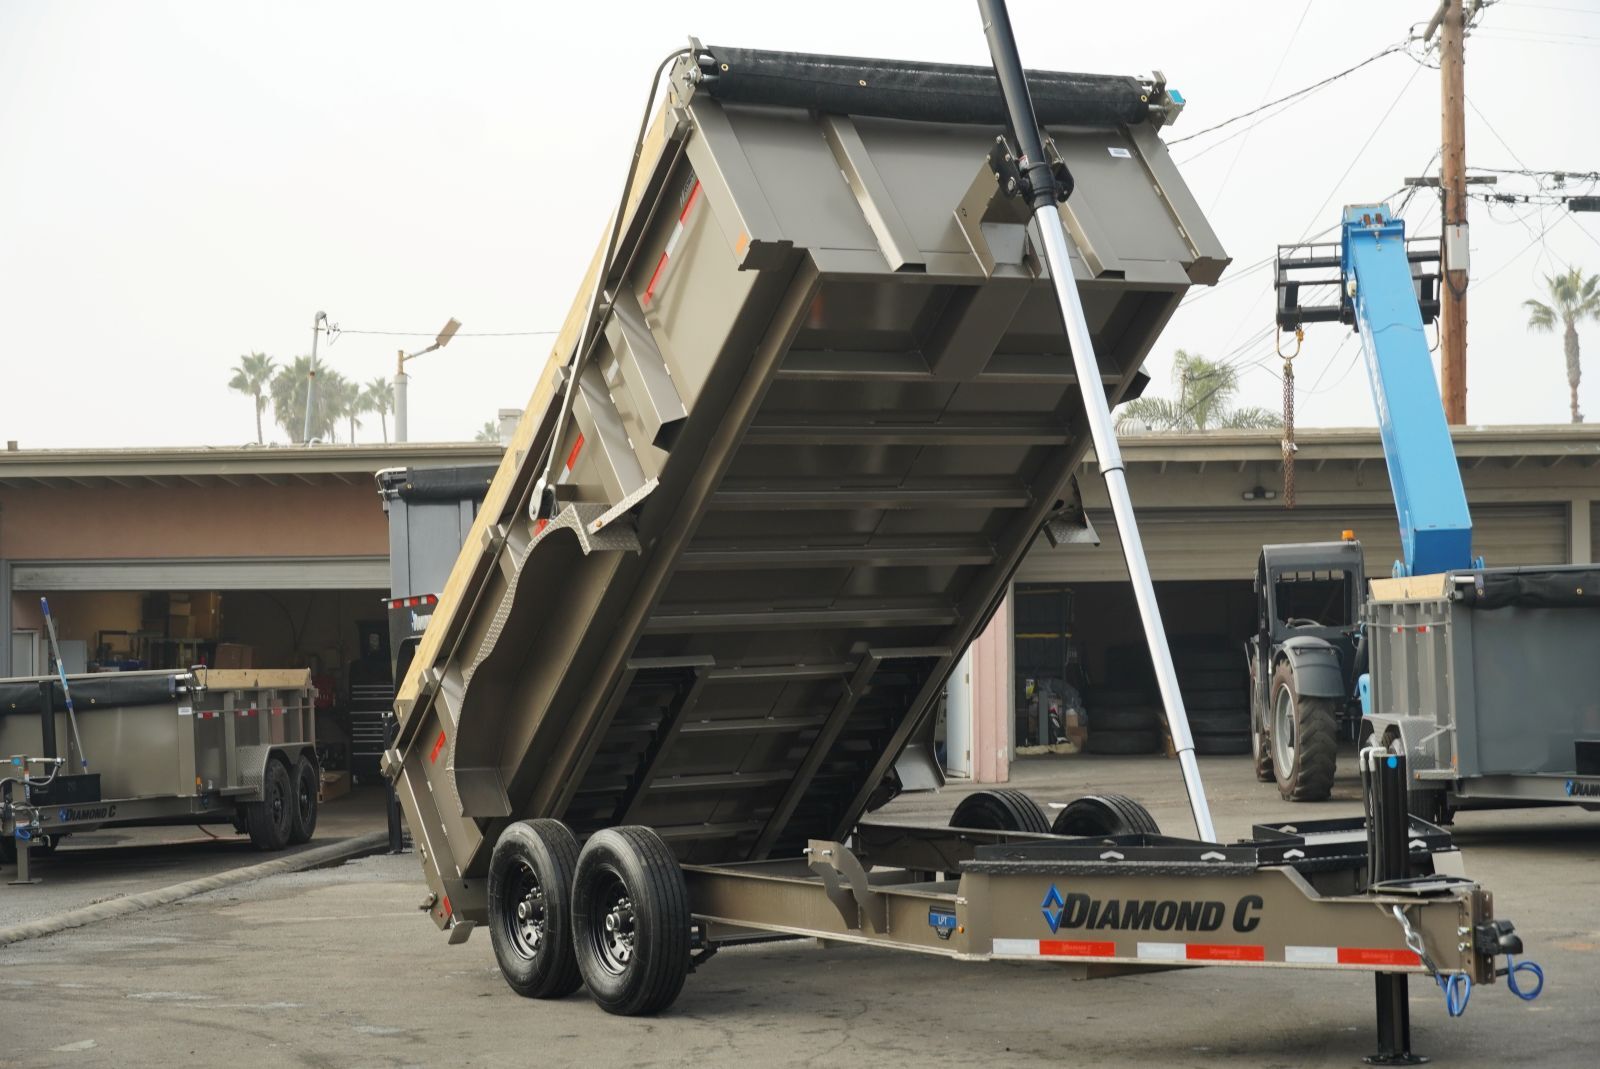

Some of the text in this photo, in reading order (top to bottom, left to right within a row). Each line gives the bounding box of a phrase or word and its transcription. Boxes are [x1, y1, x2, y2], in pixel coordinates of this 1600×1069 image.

[66, 805, 116, 821] DIAMOND C
[1059, 893, 1264, 933] DIAMOND C
